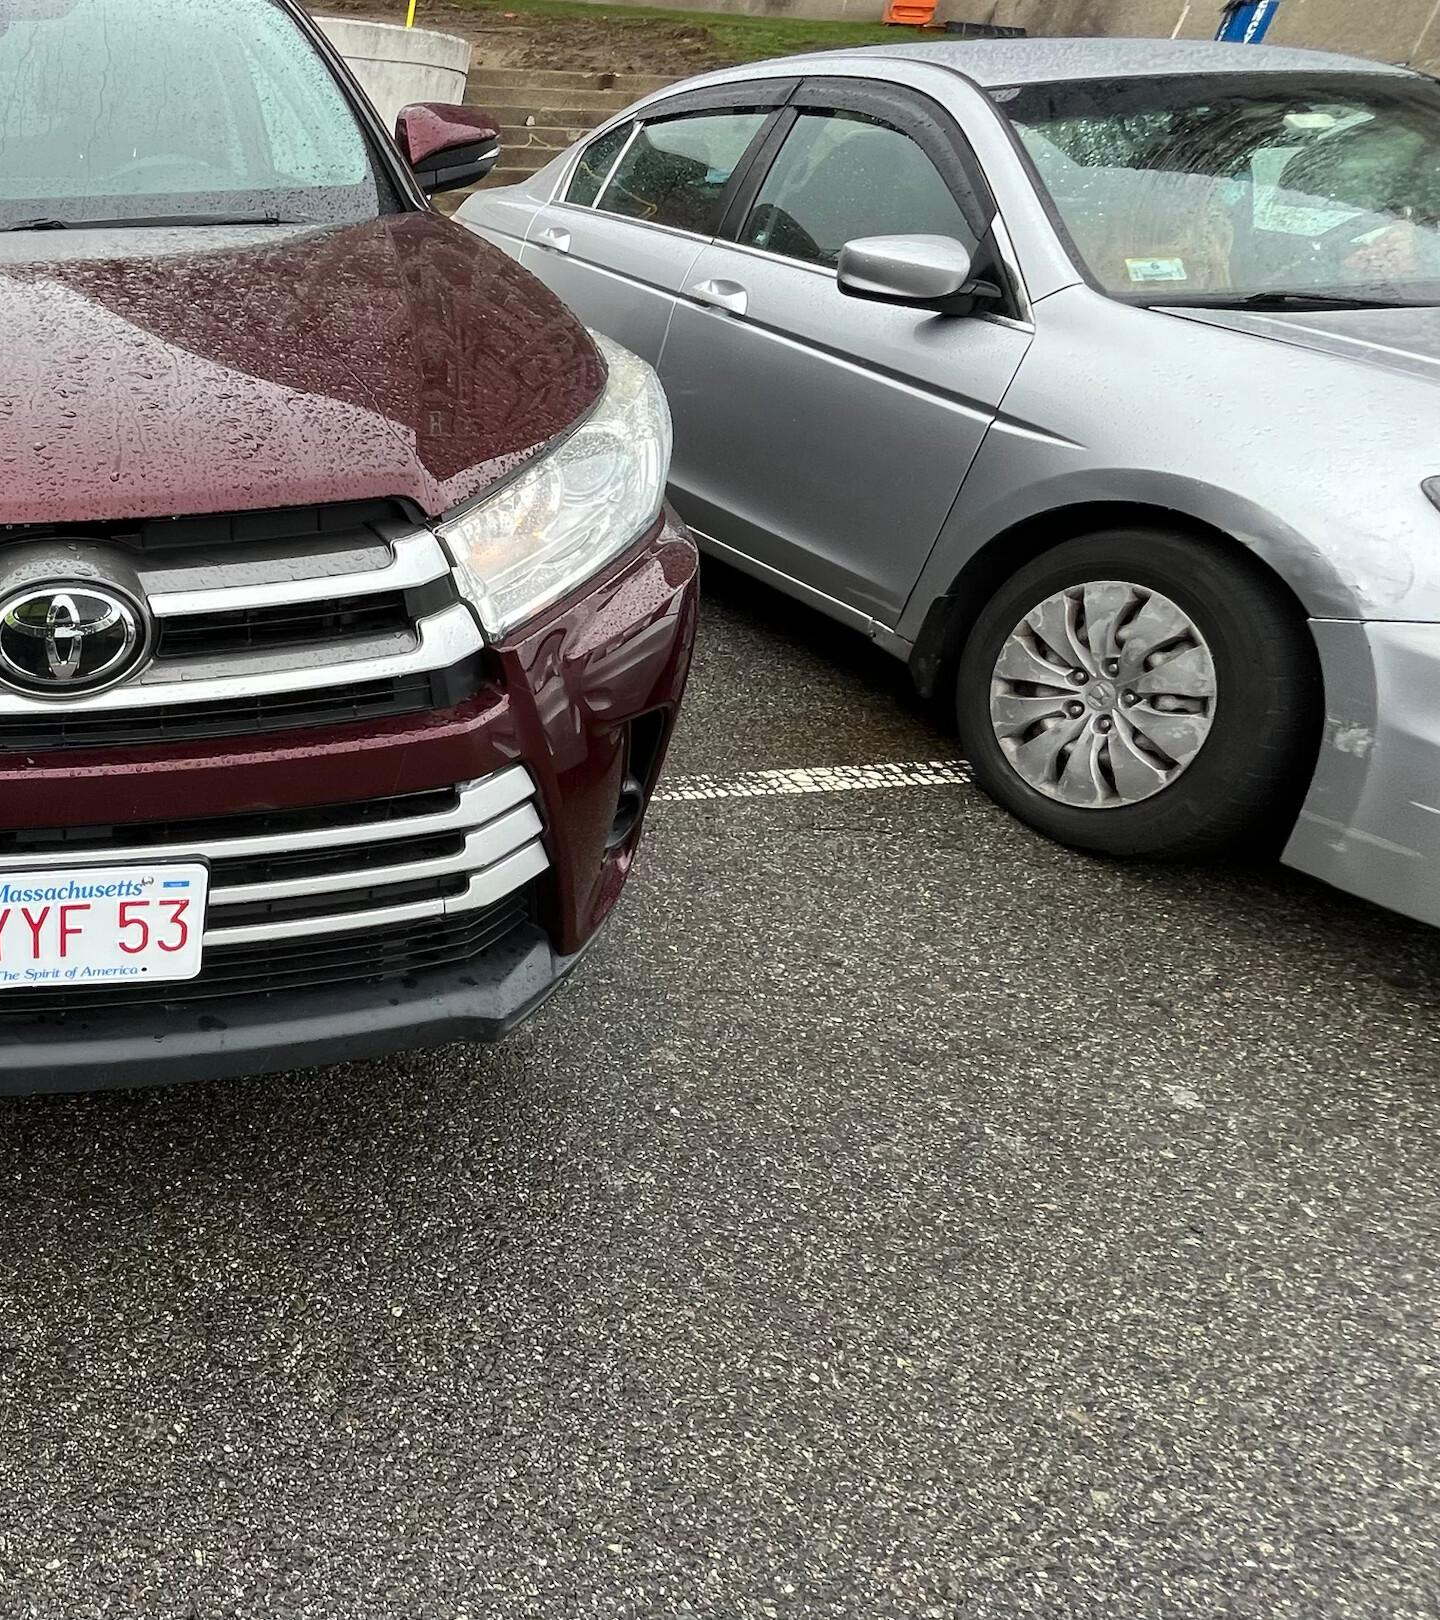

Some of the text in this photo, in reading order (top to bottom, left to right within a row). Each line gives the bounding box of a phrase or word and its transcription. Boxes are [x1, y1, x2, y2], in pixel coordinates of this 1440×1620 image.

[118, 899, 190, 954] 53
[24, 967, 60, 981] Spirit
[65, 966, 78, 979] of
[80, 964, 138, 977] America
